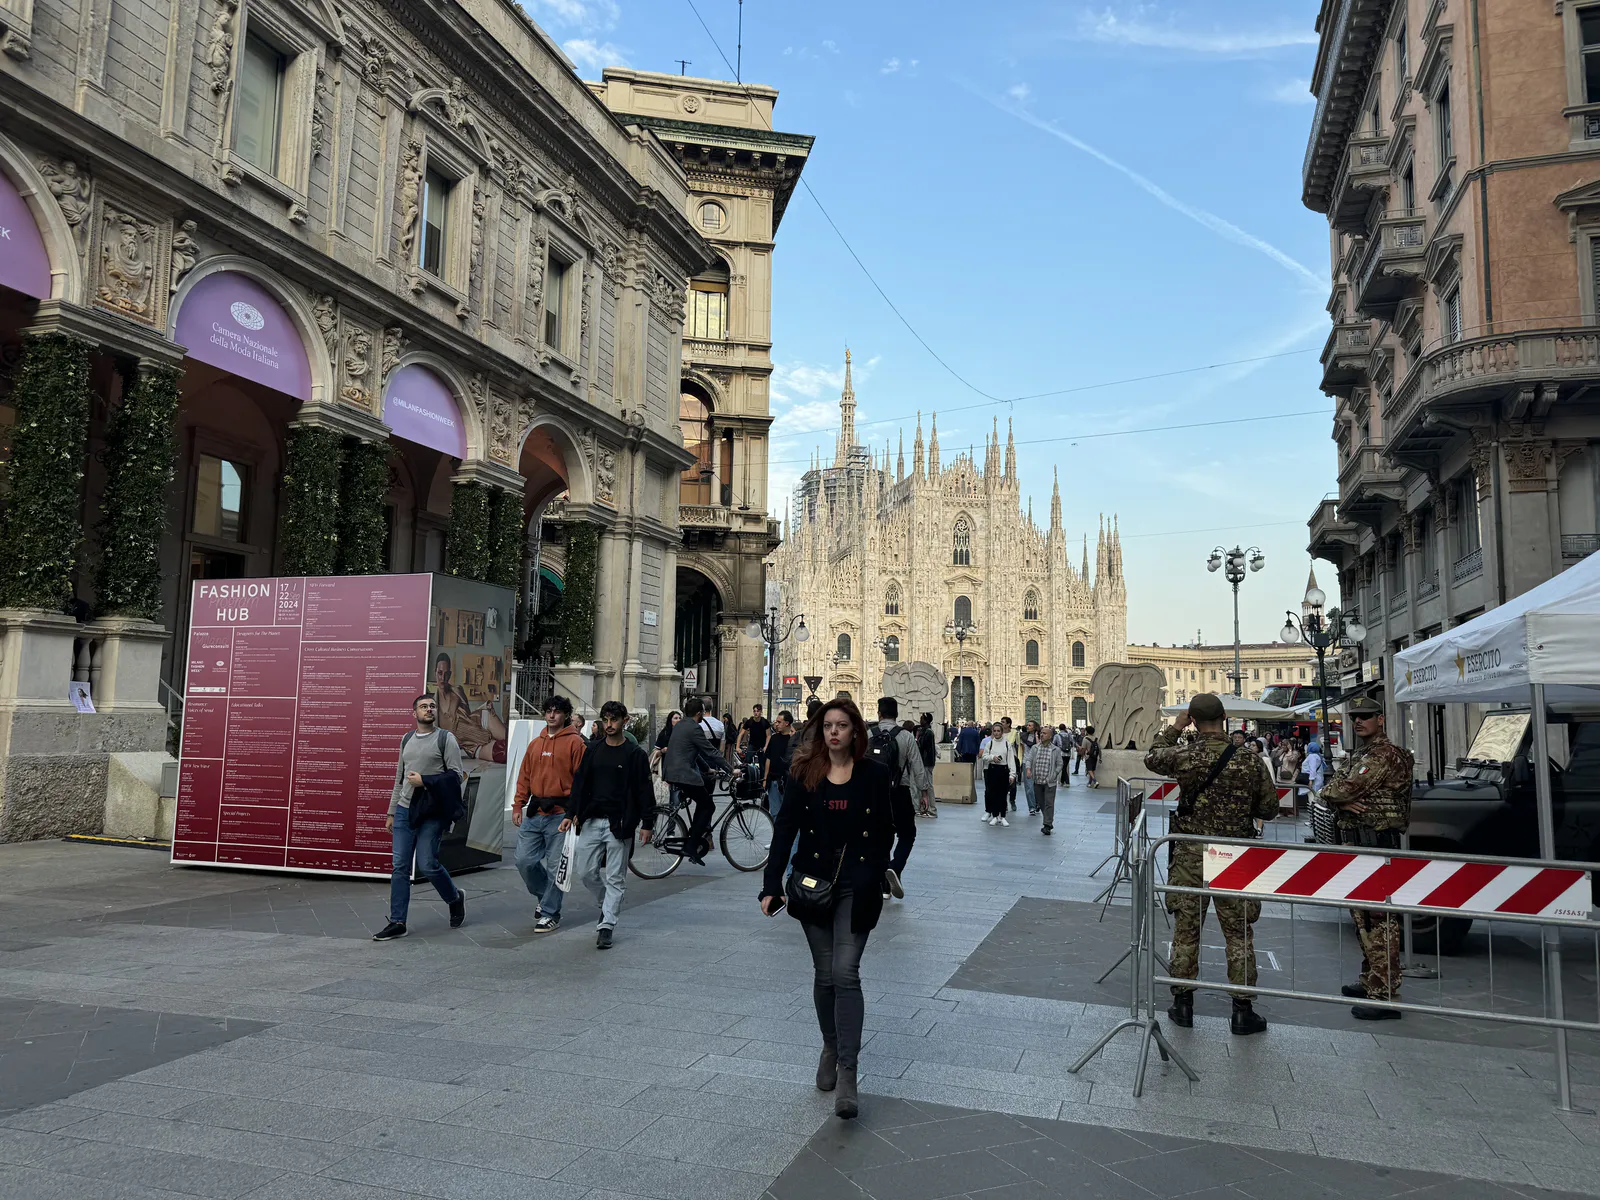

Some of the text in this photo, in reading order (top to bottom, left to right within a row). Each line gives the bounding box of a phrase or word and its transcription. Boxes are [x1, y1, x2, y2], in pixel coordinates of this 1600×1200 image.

[212, 322, 278, 357] Camera Nazionale
[210, 334, 279, 369] della Moda Italiana
[392, 396, 455, 428] @MILANFASHIONWEEK
[200, 584, 270, 598] FASHION
[279, 592, 290, 600] 22
[280, 583, 289, 592] 17
[278, 600, 298, 608] 2024
[216, 608, 249, 621] HUB
[1467, 648, 1501, 674] ESERCITO
[1413, 664, 1438, 684] ESERCITO
